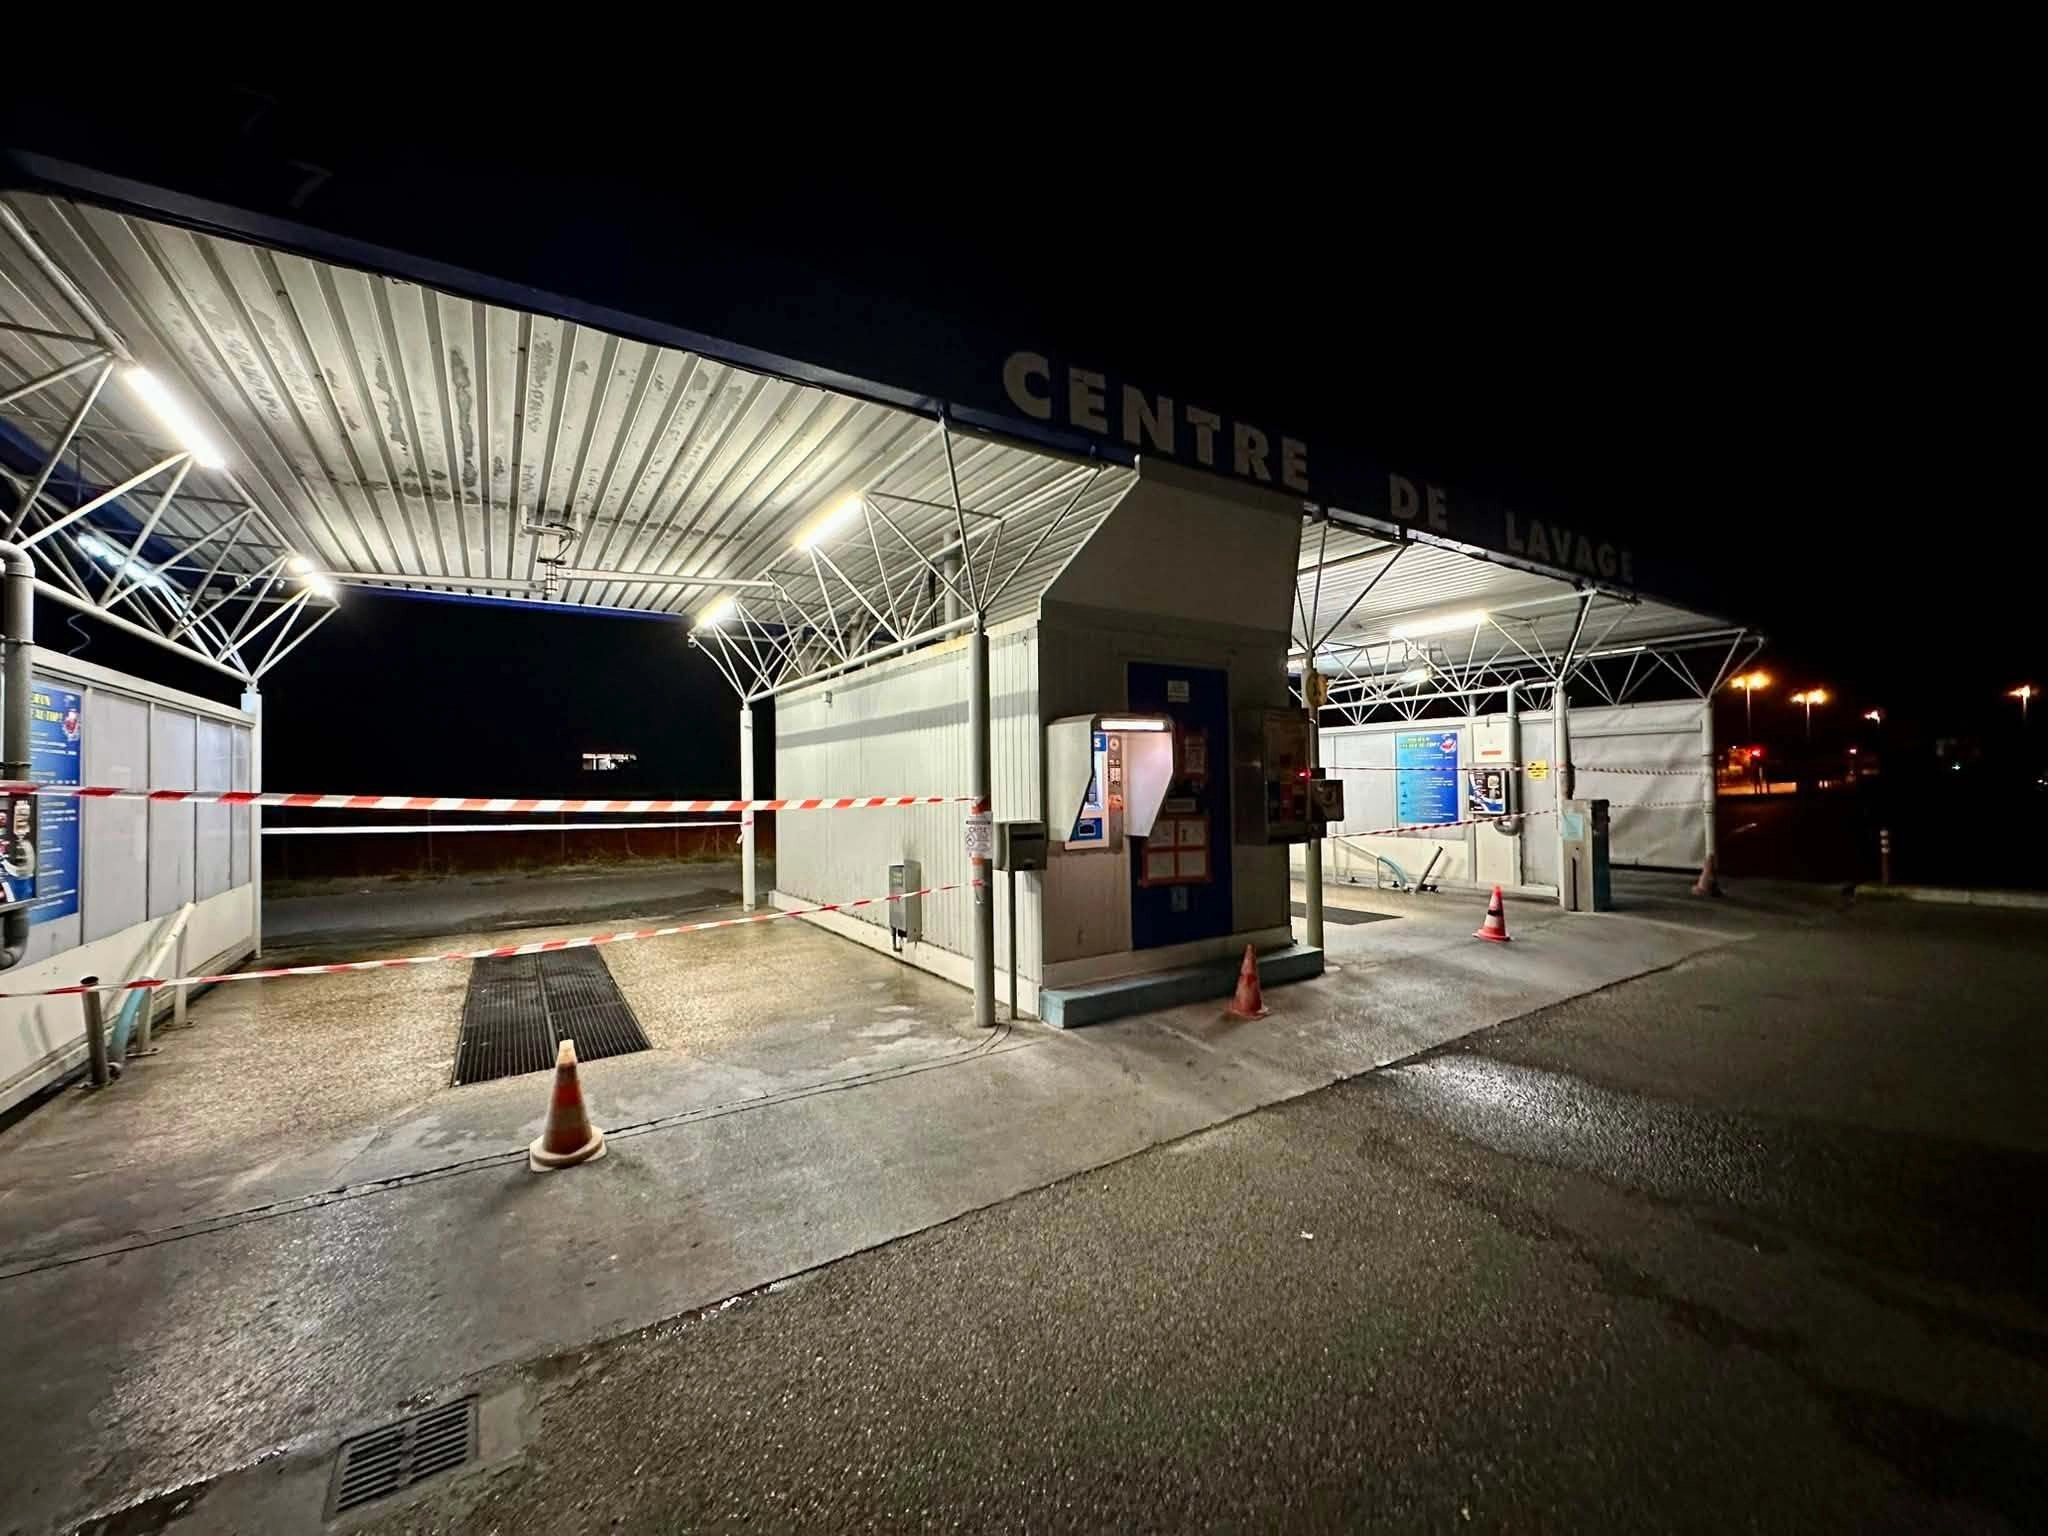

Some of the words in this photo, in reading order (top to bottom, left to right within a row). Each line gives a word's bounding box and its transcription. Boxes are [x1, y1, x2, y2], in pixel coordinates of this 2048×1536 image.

[1001, 350, 1312, 491] CENTRE
[1388, 471, 1450, 533] DE
[1504, 511, 1635, 584] LAVAGE
